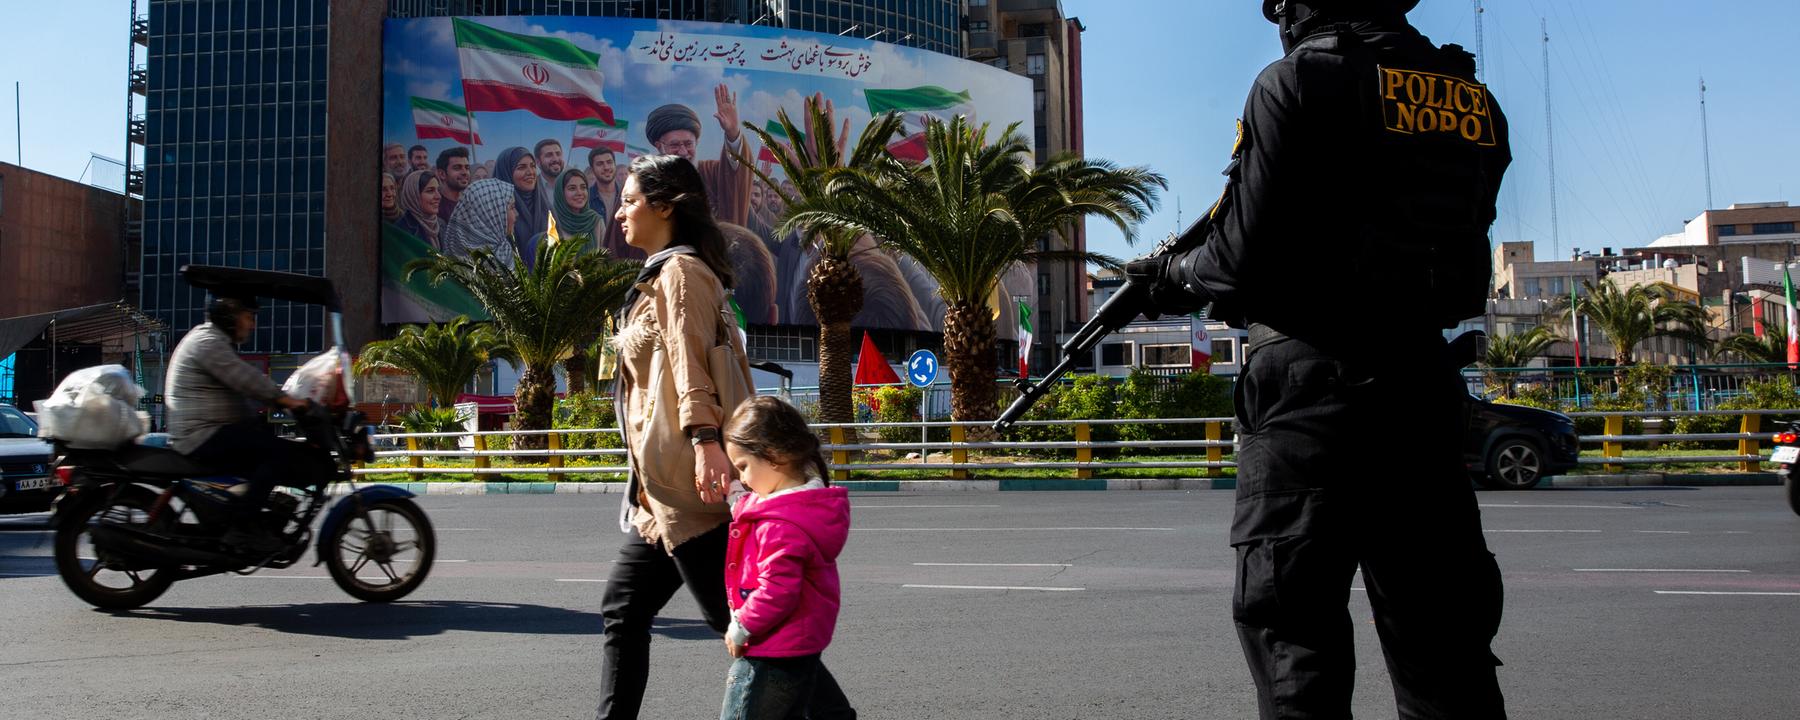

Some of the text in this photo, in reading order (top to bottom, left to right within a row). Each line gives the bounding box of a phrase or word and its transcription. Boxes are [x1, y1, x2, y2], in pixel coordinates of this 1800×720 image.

[673, 40, 699, 62] زمین
[698, 45, 709, 62] بر
[709, 42, 746, 66] پرچمت
[760, 41, 795, 62] بهشت
[849, 52, 872, 77] خوش
[1385, 69, 1487, 117] POLICE
[1396, 102, 1482, 142] NOPO
